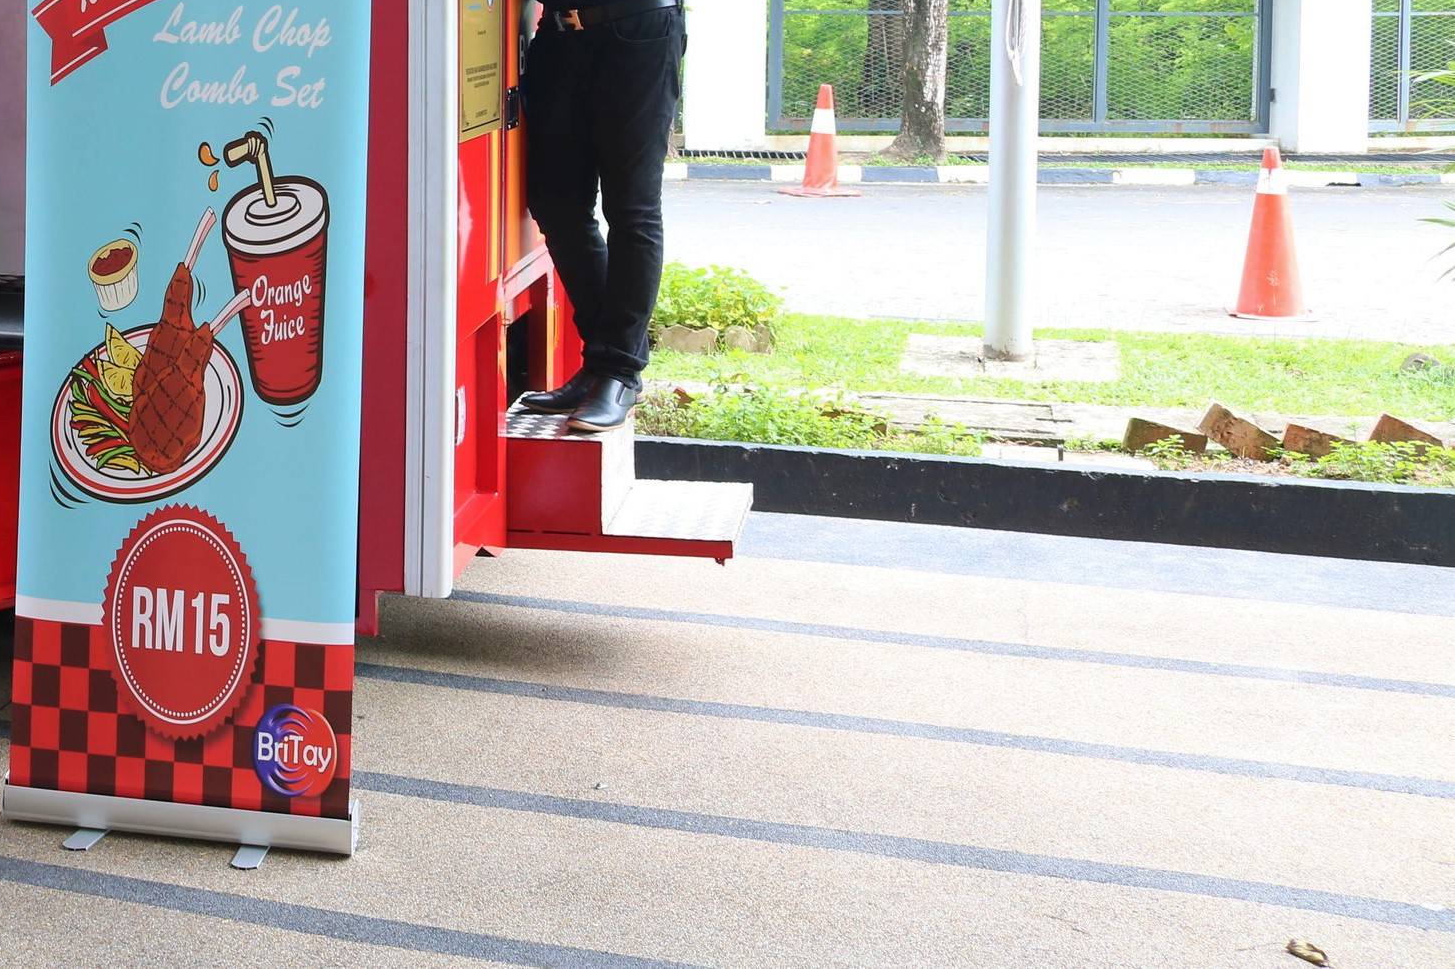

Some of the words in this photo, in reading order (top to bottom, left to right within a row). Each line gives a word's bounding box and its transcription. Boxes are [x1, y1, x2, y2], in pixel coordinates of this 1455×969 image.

[152, 1, 243, 46] Lamb
[251, 4, 333, 59] Chop
[159, 61, 259, 110] Combo
[270, 65, 327, 109] Set
[251, 274, 313, 308] Orange
[259, 309, 306, 346] Juice
[256, 730, 332, 773] BriTay
